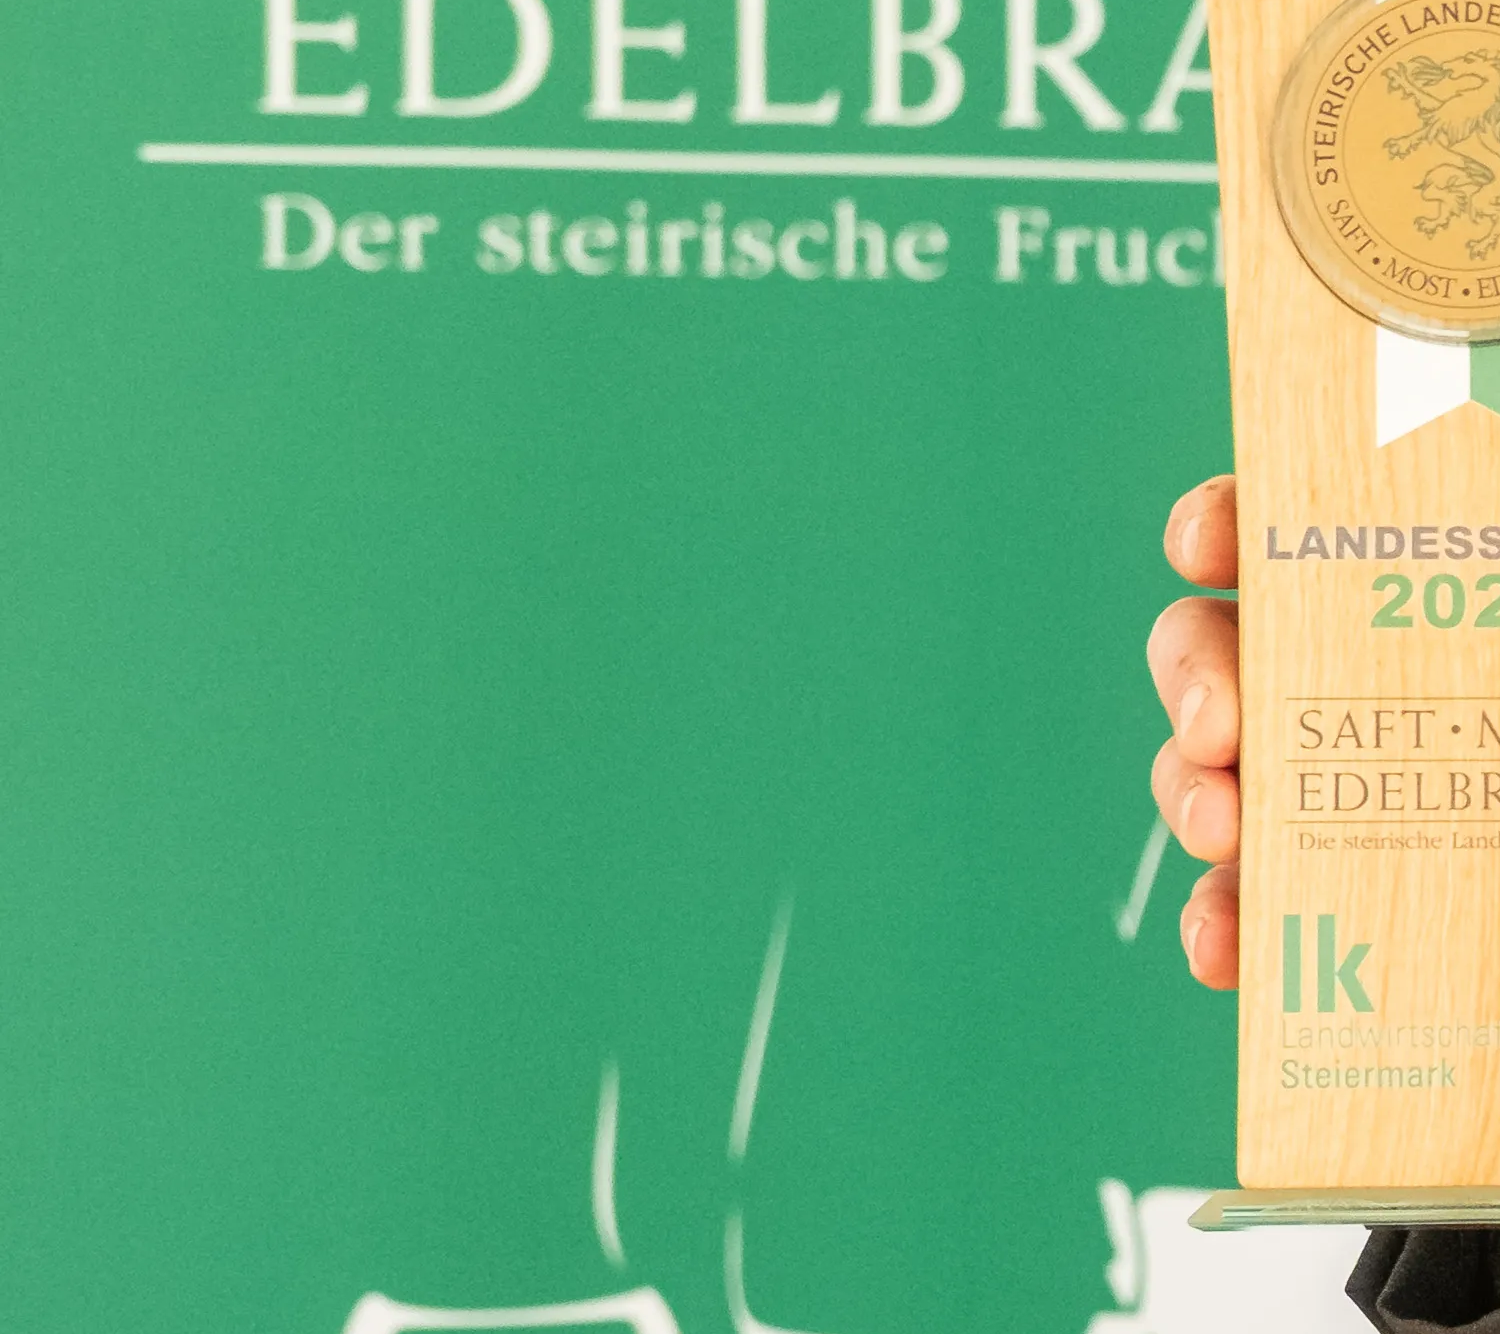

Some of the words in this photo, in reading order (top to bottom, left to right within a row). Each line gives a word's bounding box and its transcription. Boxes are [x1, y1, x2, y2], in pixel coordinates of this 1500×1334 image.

[1313, 23, 1398, 185] STEIRISCHE
[259, 194, 438, 270] Der
[477, 199, 950, 283] steirische
[1327, 198, 1377, 254] SAFT
[1382, 256, 1457, 298] MOST
[1299, 709, 1436, 750] SAFT
[1298, 832, 1335, 850] Die
[1343, 832, 1442, 850] steirische
[1282, 914, 1375, 1013] lk
[1281, 1058, 1457, 1088] Steiermark
